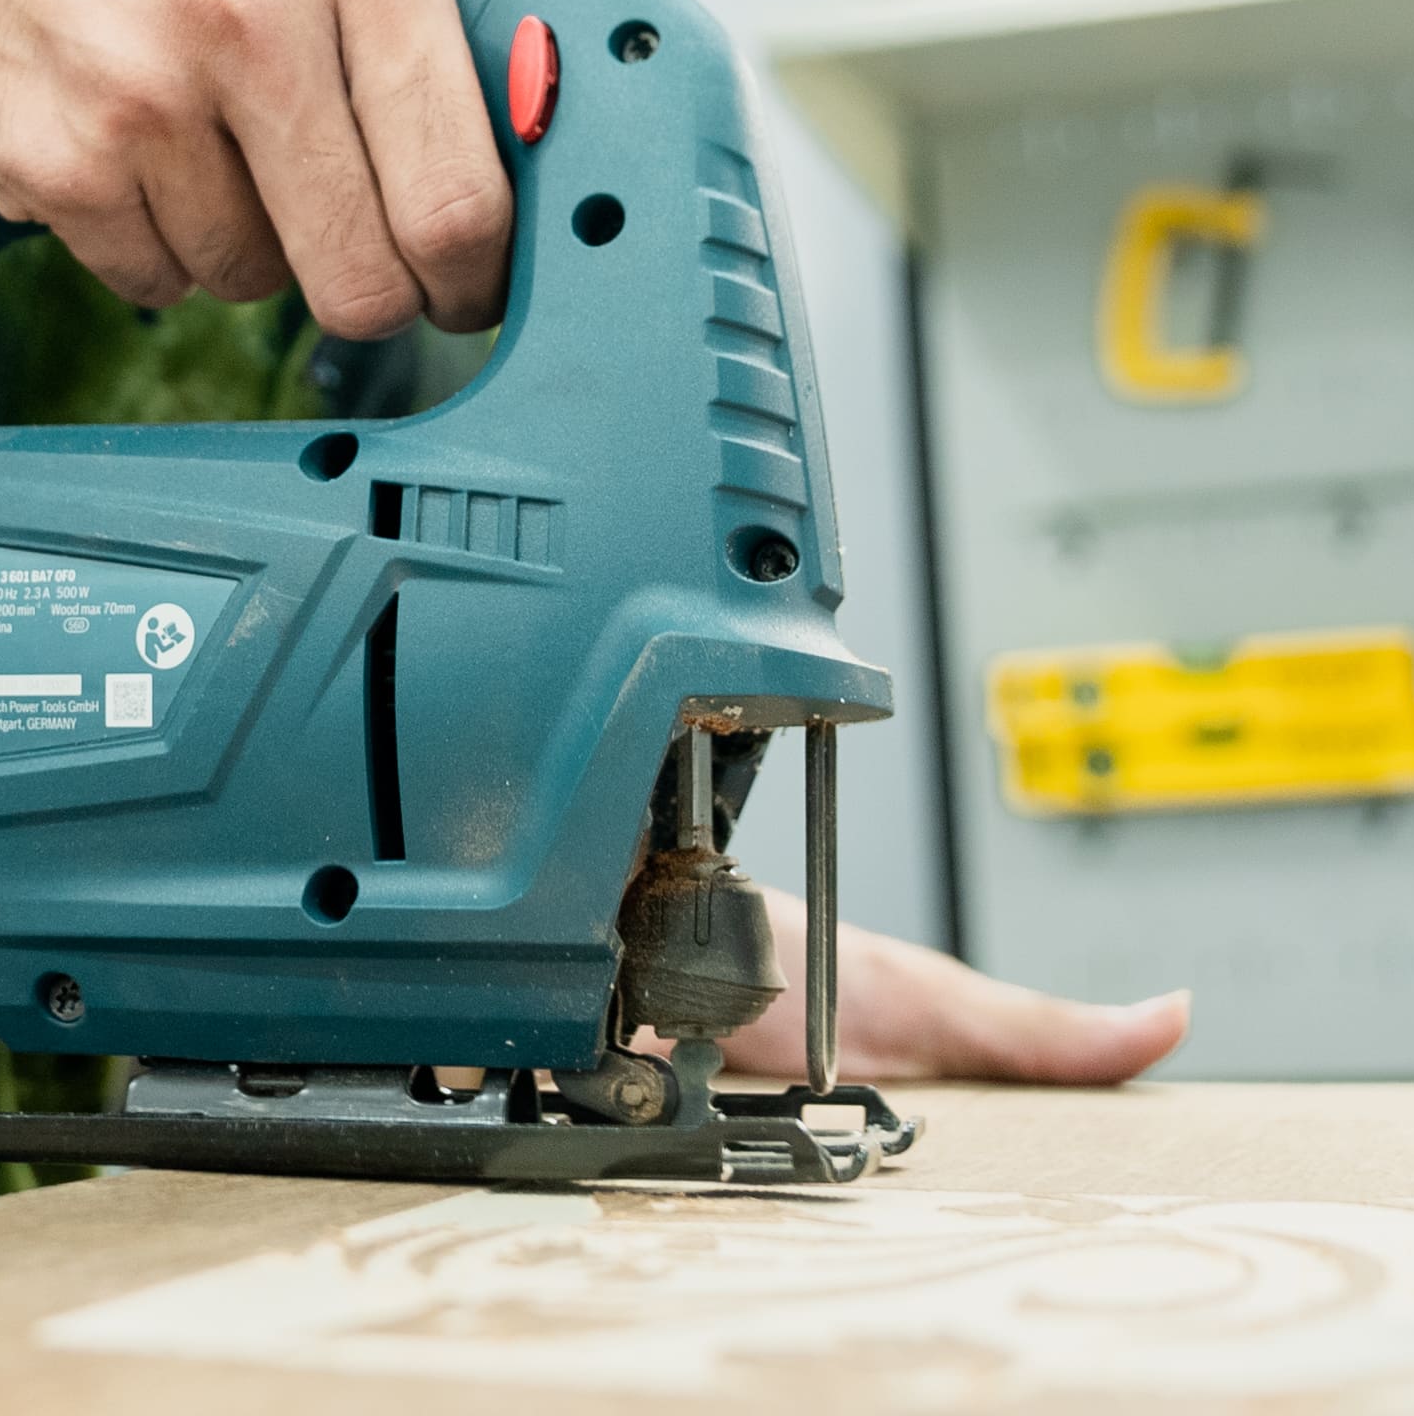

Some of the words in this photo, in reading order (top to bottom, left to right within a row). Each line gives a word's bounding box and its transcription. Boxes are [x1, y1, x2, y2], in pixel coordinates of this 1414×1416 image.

[4, 587, 18, 600] Hz
[23, 586, 41, 600] 2.3
[42, 586, 50, 599] A
[56, 586, 77, 599] 500
[78, 586, 90, 599] W
[50, 602, 79, 616] Wood
[80, 604, 101, 615] max
[103, 602, 136, 615] 70mm
[9, 700, 39, 713] Power
[41, 700, 67, 713] Tools
[67, 700, 100, 713] GmbH
[26, 716, 77, 730] GERMANY
